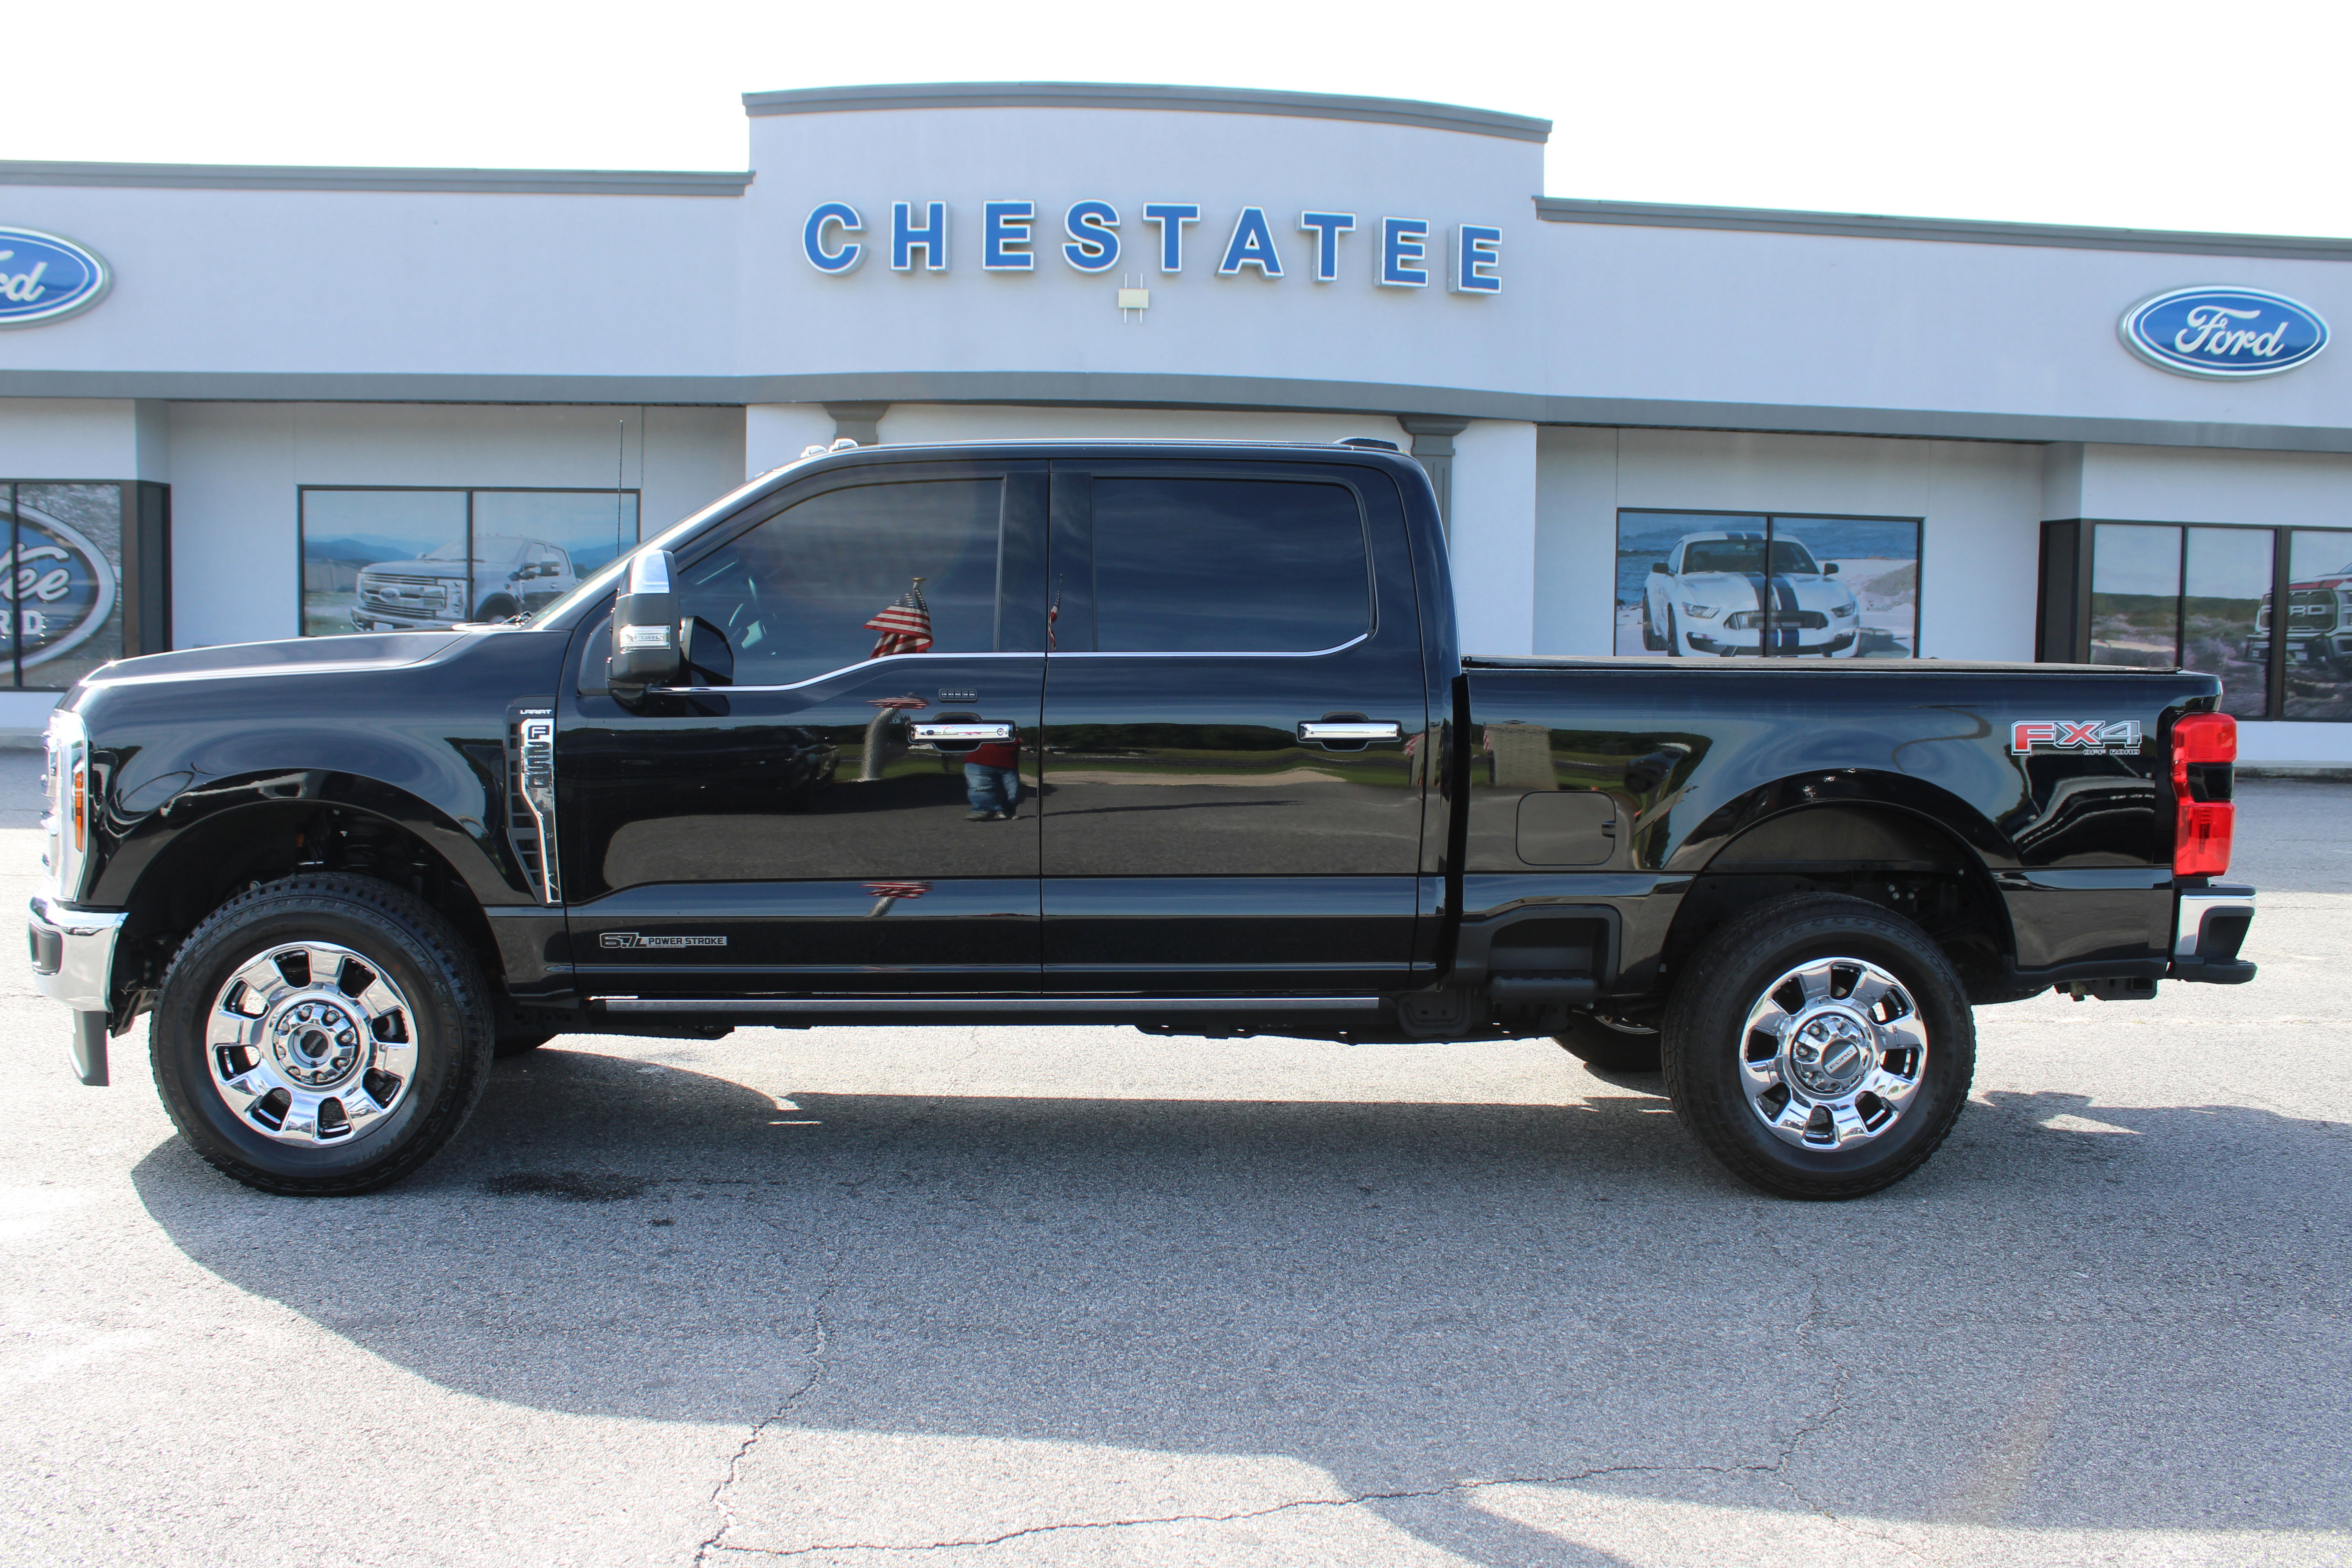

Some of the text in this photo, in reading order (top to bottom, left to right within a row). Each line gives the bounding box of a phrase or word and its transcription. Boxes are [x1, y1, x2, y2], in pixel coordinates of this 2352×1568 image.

[802, 199, 1502, 295] CHESTATEE
[2174, 305, 2290, 358] Ford
[2260, 605, 2326, 616] FRD
[2011, 720, 2142, 755] FX4
[599, 932, 647, 948] 6.7L
[1830, 1049, 1853, 1069] FORD
